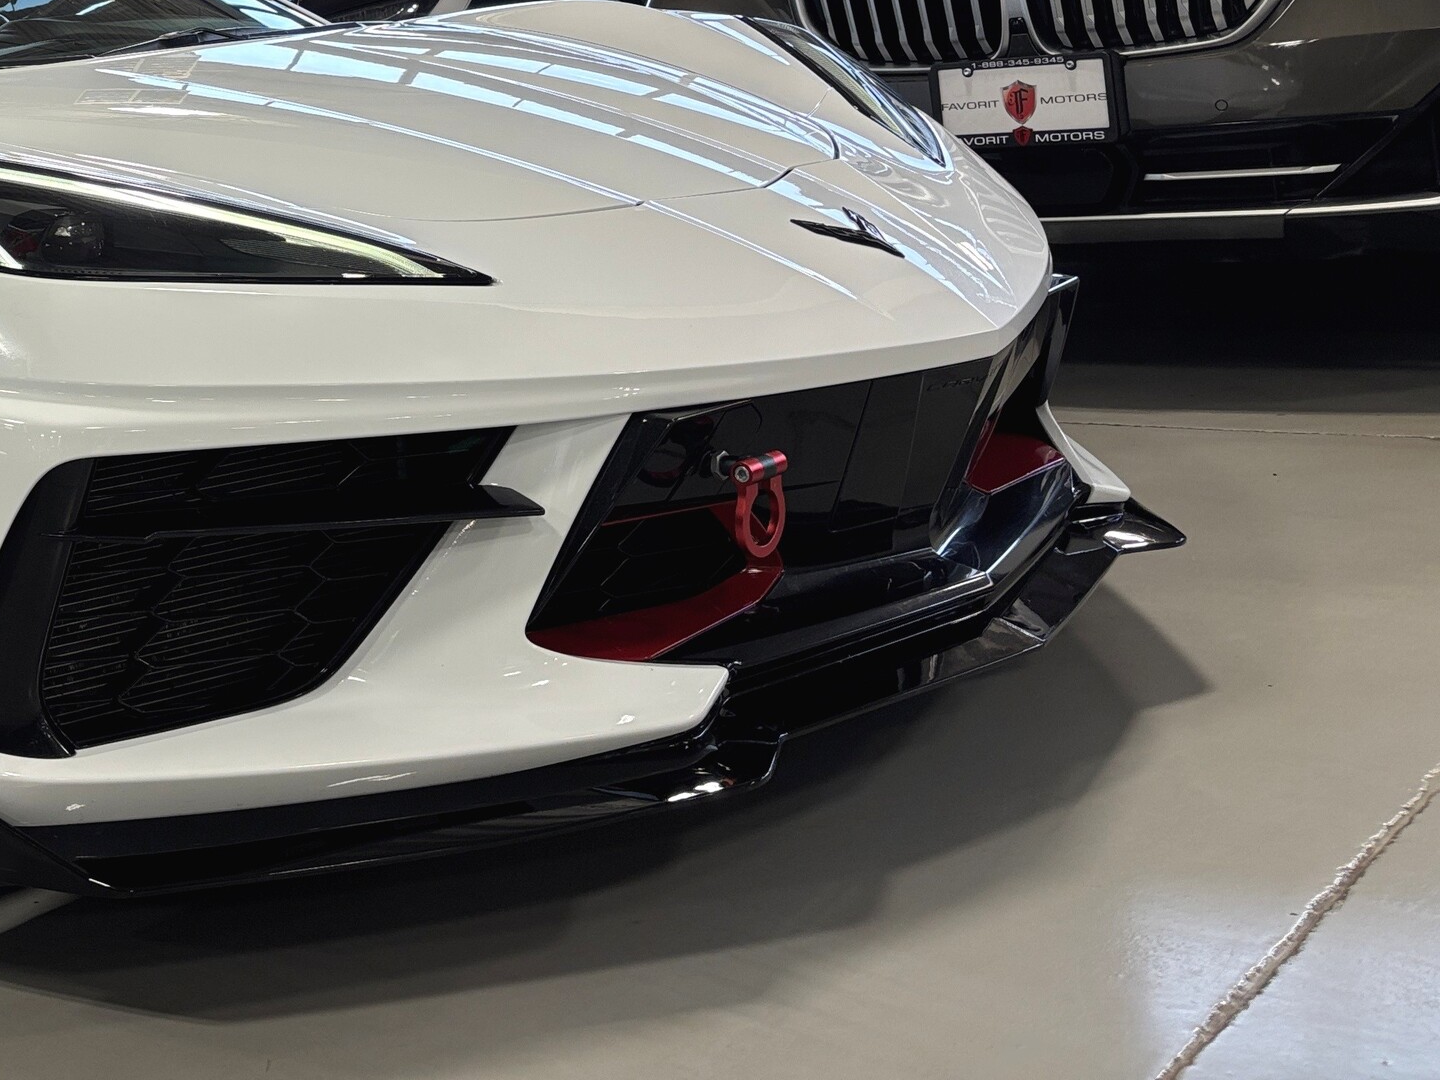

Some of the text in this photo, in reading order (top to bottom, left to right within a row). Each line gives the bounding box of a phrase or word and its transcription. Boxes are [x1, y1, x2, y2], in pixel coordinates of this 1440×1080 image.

[941, 100, 1000, 112] FAVORIT
[1040, 92, 1107, 105] MOTORS
[963, 135, 1009, 146] VORIT
[1035, 131, 1105, 143] MOTORS
